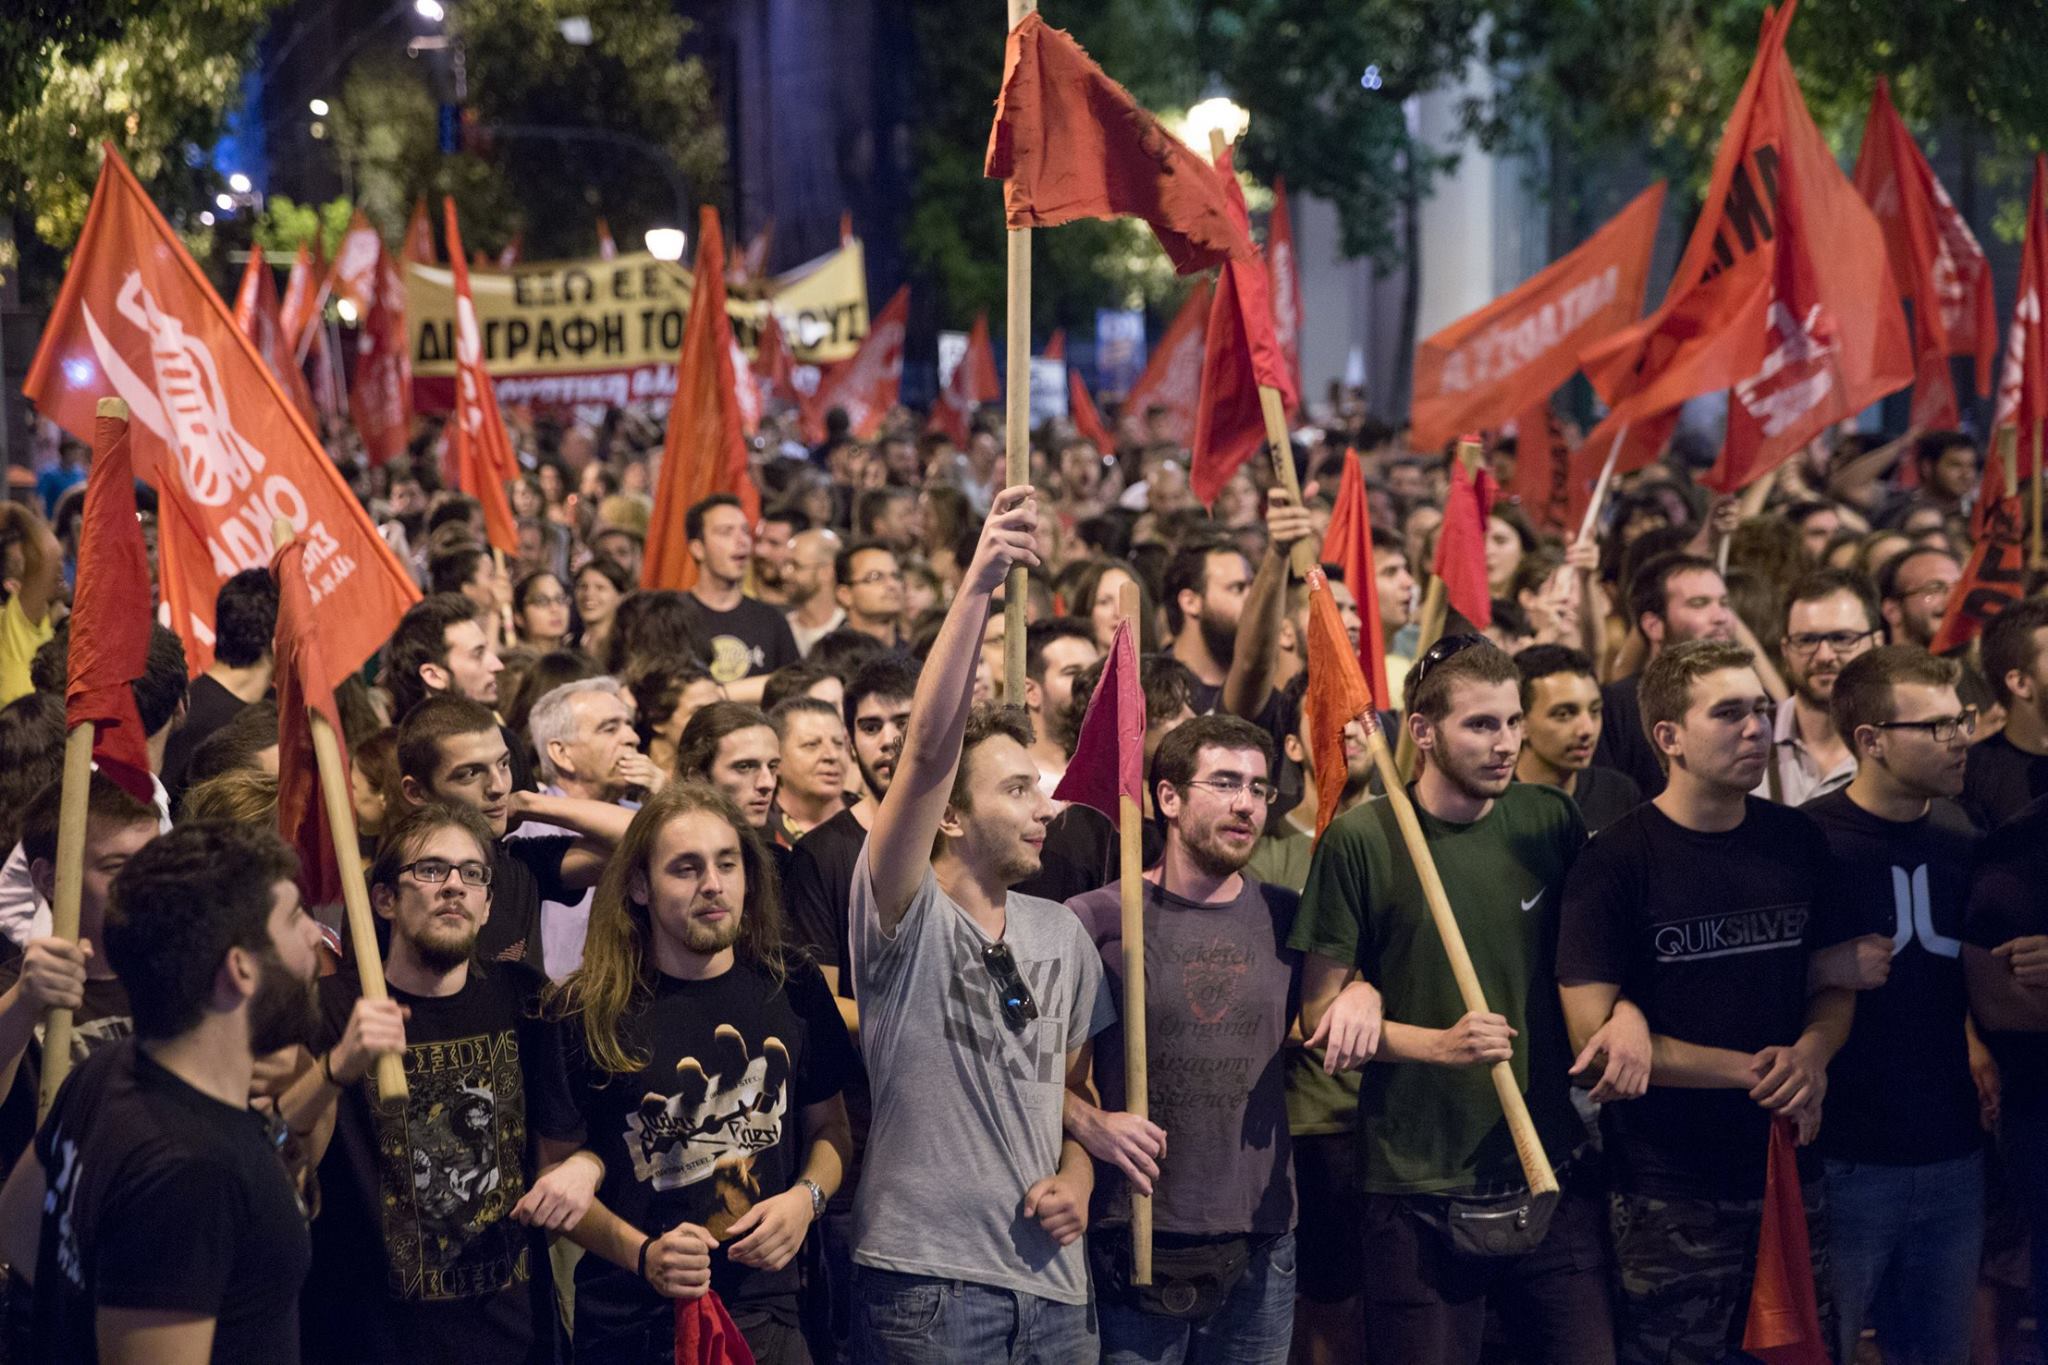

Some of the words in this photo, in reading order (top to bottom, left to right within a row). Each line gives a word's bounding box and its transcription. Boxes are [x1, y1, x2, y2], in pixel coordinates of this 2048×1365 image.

[418, 313, 624, 362] ΔΙΓΡΑΦΗ
[640, 307, 685, 350] ΤΟ
[727, 1118, 780, 1150] Priest
